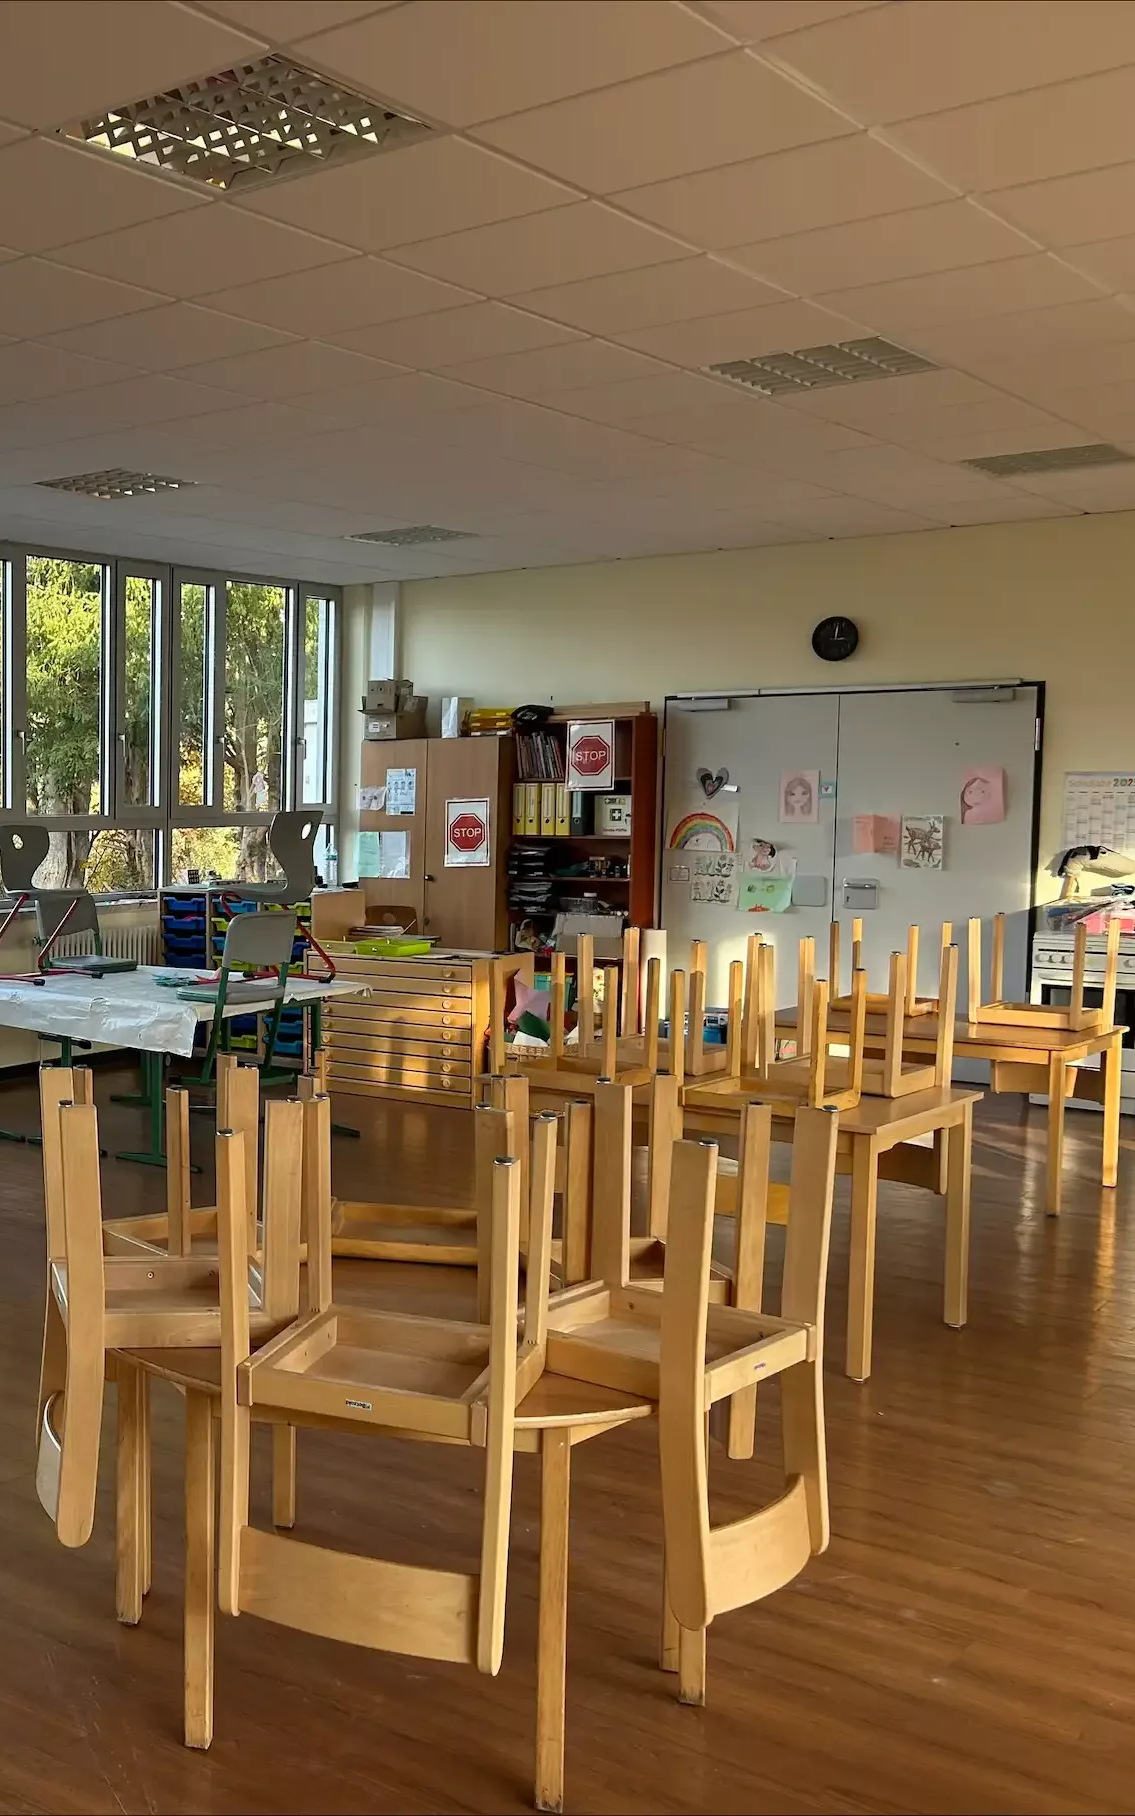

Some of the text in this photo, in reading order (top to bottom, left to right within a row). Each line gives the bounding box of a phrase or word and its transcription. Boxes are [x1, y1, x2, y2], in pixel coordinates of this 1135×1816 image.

[575, 750, 606, 762] STOP
[1113, 778, 1135, 787] 202
[453, 827, 482, 839] STOP
